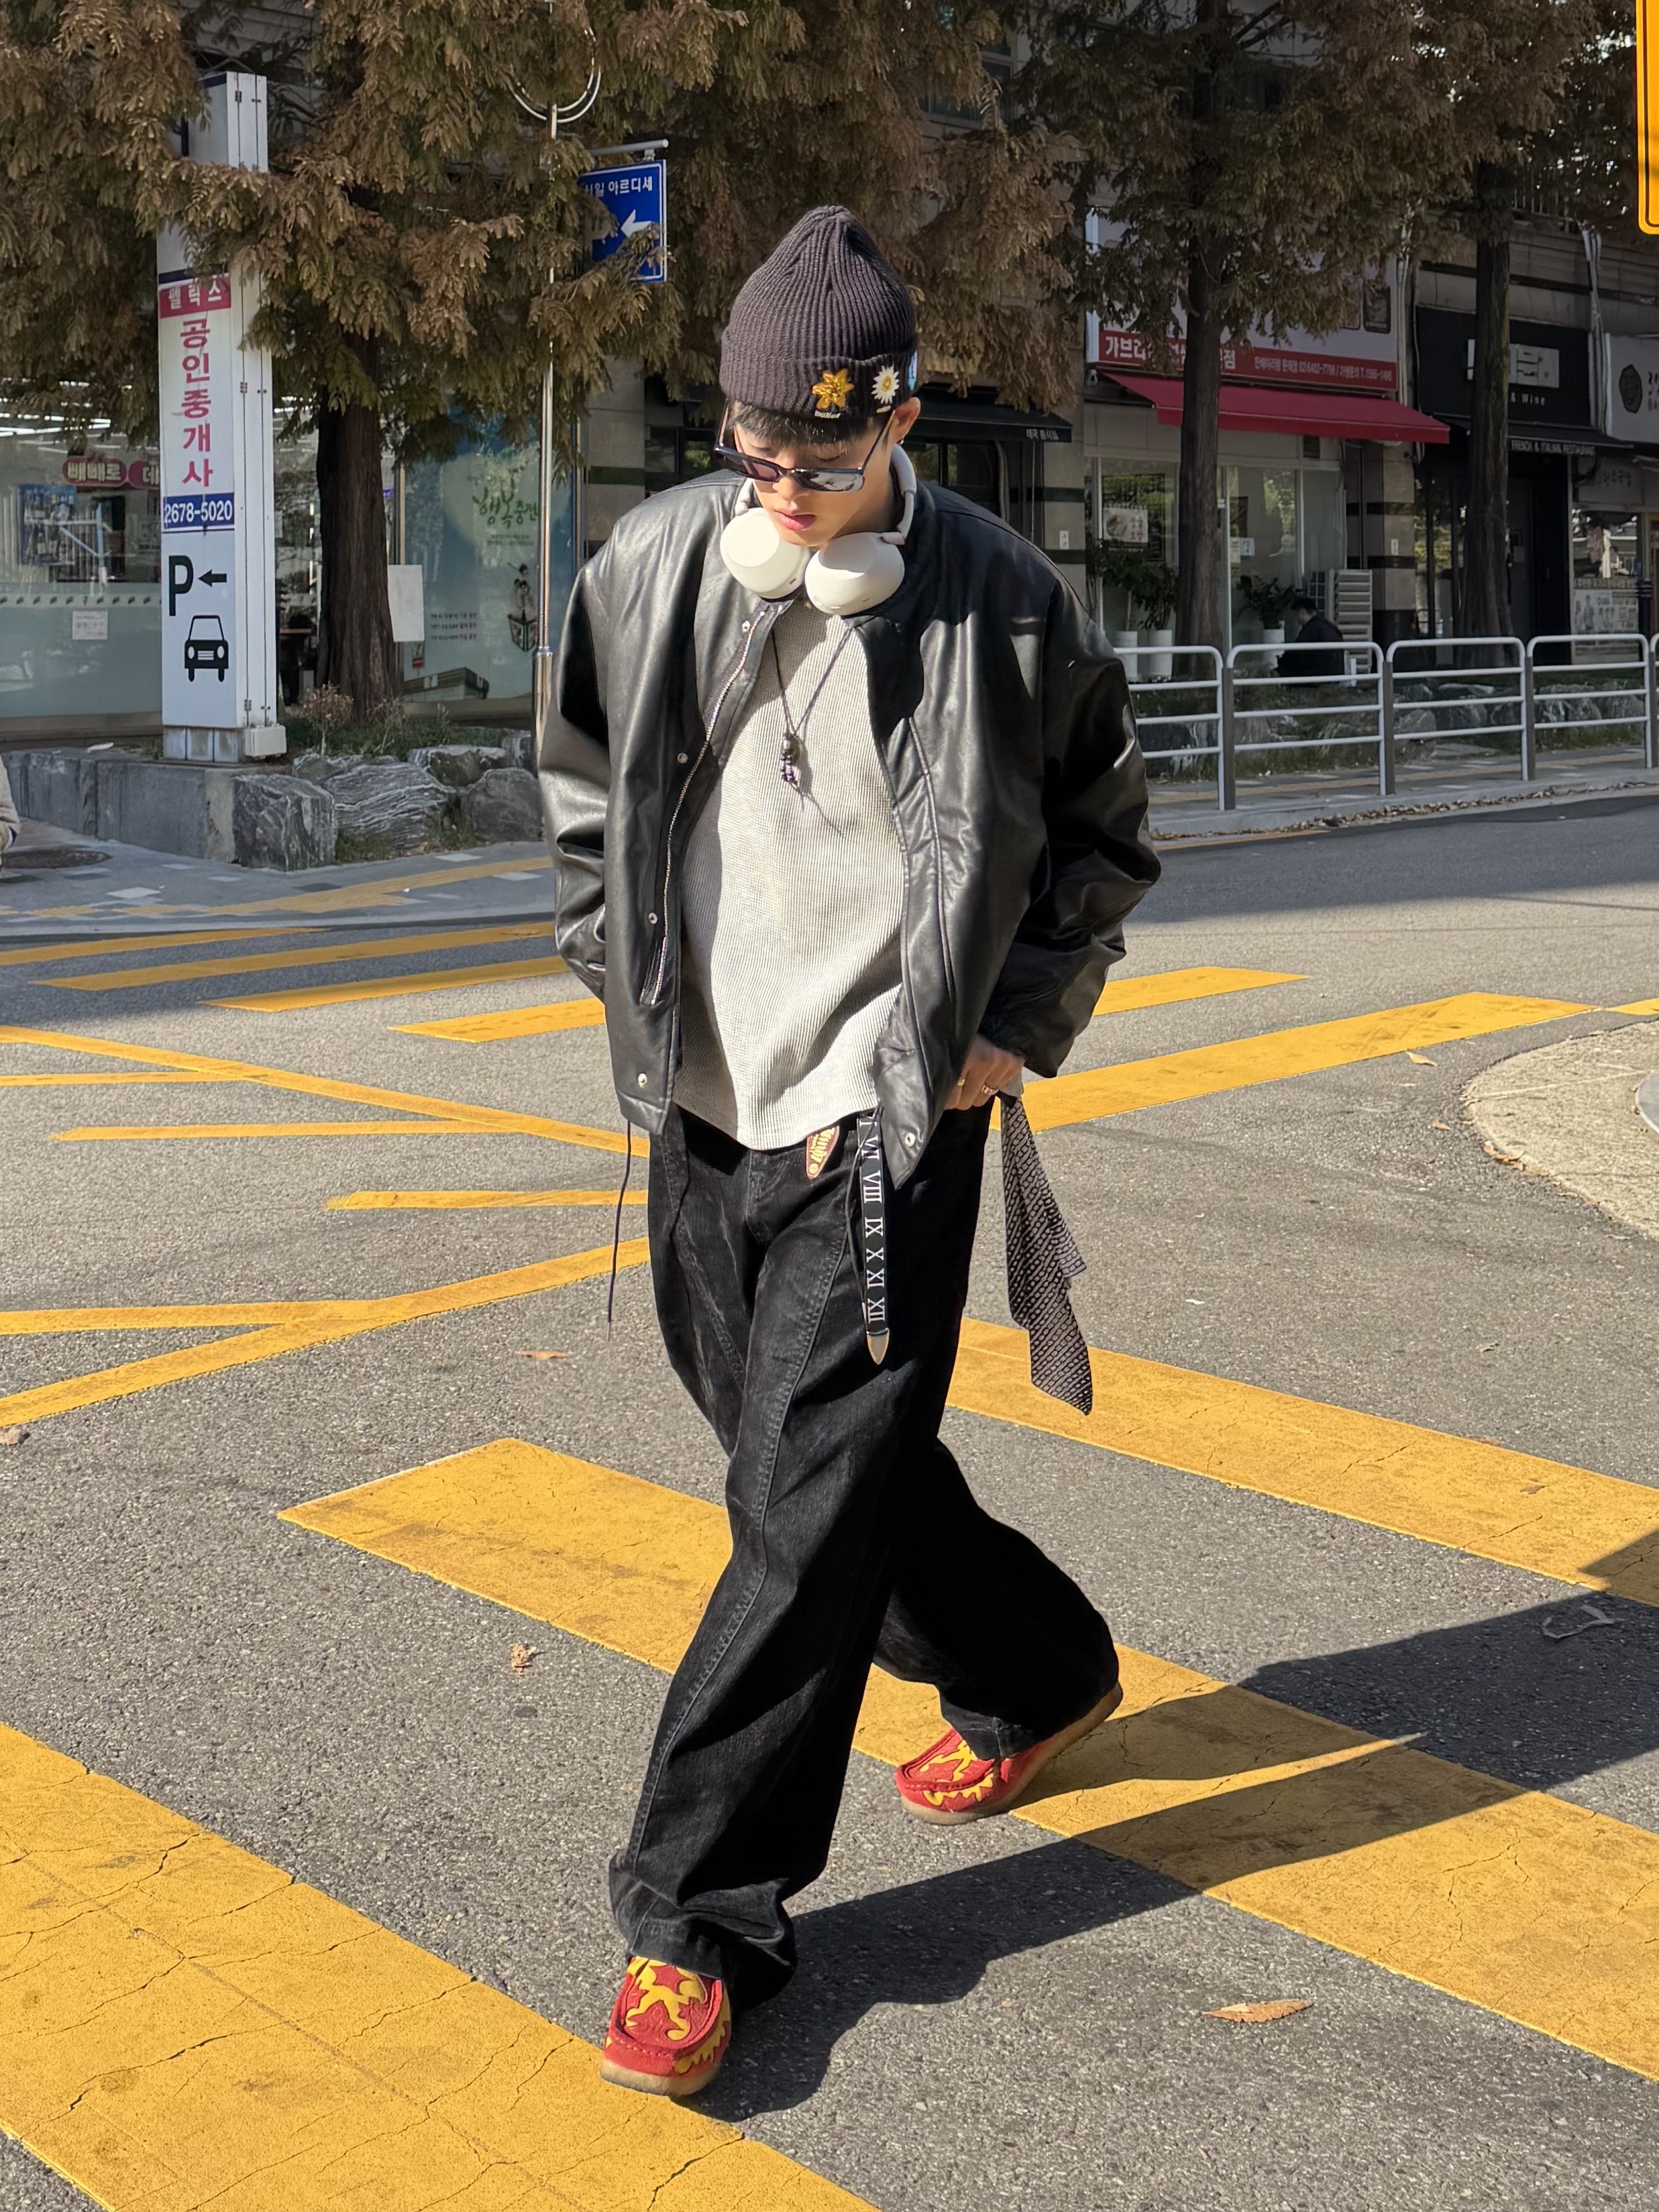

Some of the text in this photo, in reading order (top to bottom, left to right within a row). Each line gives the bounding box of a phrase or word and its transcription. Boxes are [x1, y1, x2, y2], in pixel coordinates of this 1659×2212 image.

[608, 176, 653, 195] 아르디세
[180, 318, 213, 488] 공인중개사
[67, 462, 121, 482] 빼빼로
[164, 499, 233, 524] 2678-5020
[168, 555, 194, 617] P
[863, 1170, 883, 1204] VIII
[865, 1216, 884, 1238] IX
[865, 1247, 885, 1263] X
[866, 1268, 885, 1289] XI
[867, 1297, 886, 1324] XII
